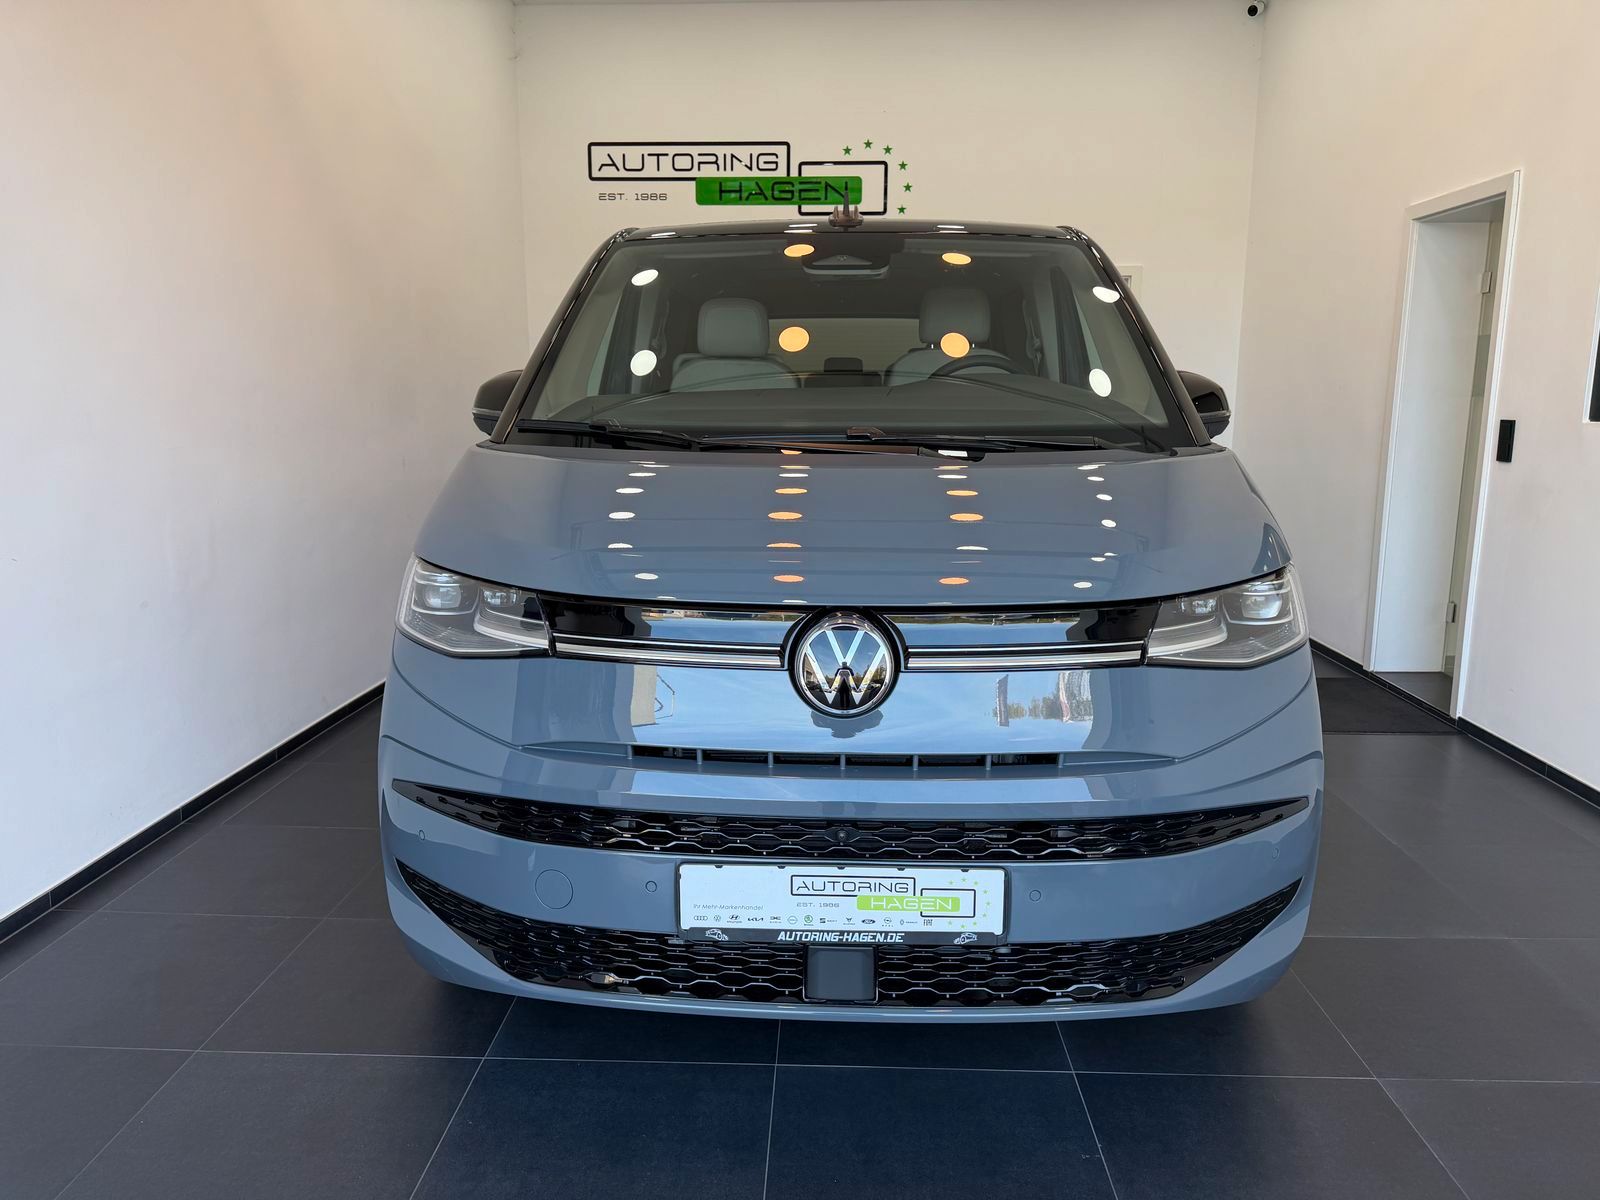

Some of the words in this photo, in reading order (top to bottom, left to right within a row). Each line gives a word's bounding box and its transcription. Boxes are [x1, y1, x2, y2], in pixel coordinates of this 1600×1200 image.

[598, 153, 779, 172] AUTORING
[598, 192, 628, 201] EST.
[634, 192, 668, 201] 1986
[719, 181, 849, 201] HAGEN
[796, 880, 909, 893] AUTORING
[871, 897, 952, 910] HAGEN
[777, 931, 905, 943] AUTORING-HAGEN.DE
